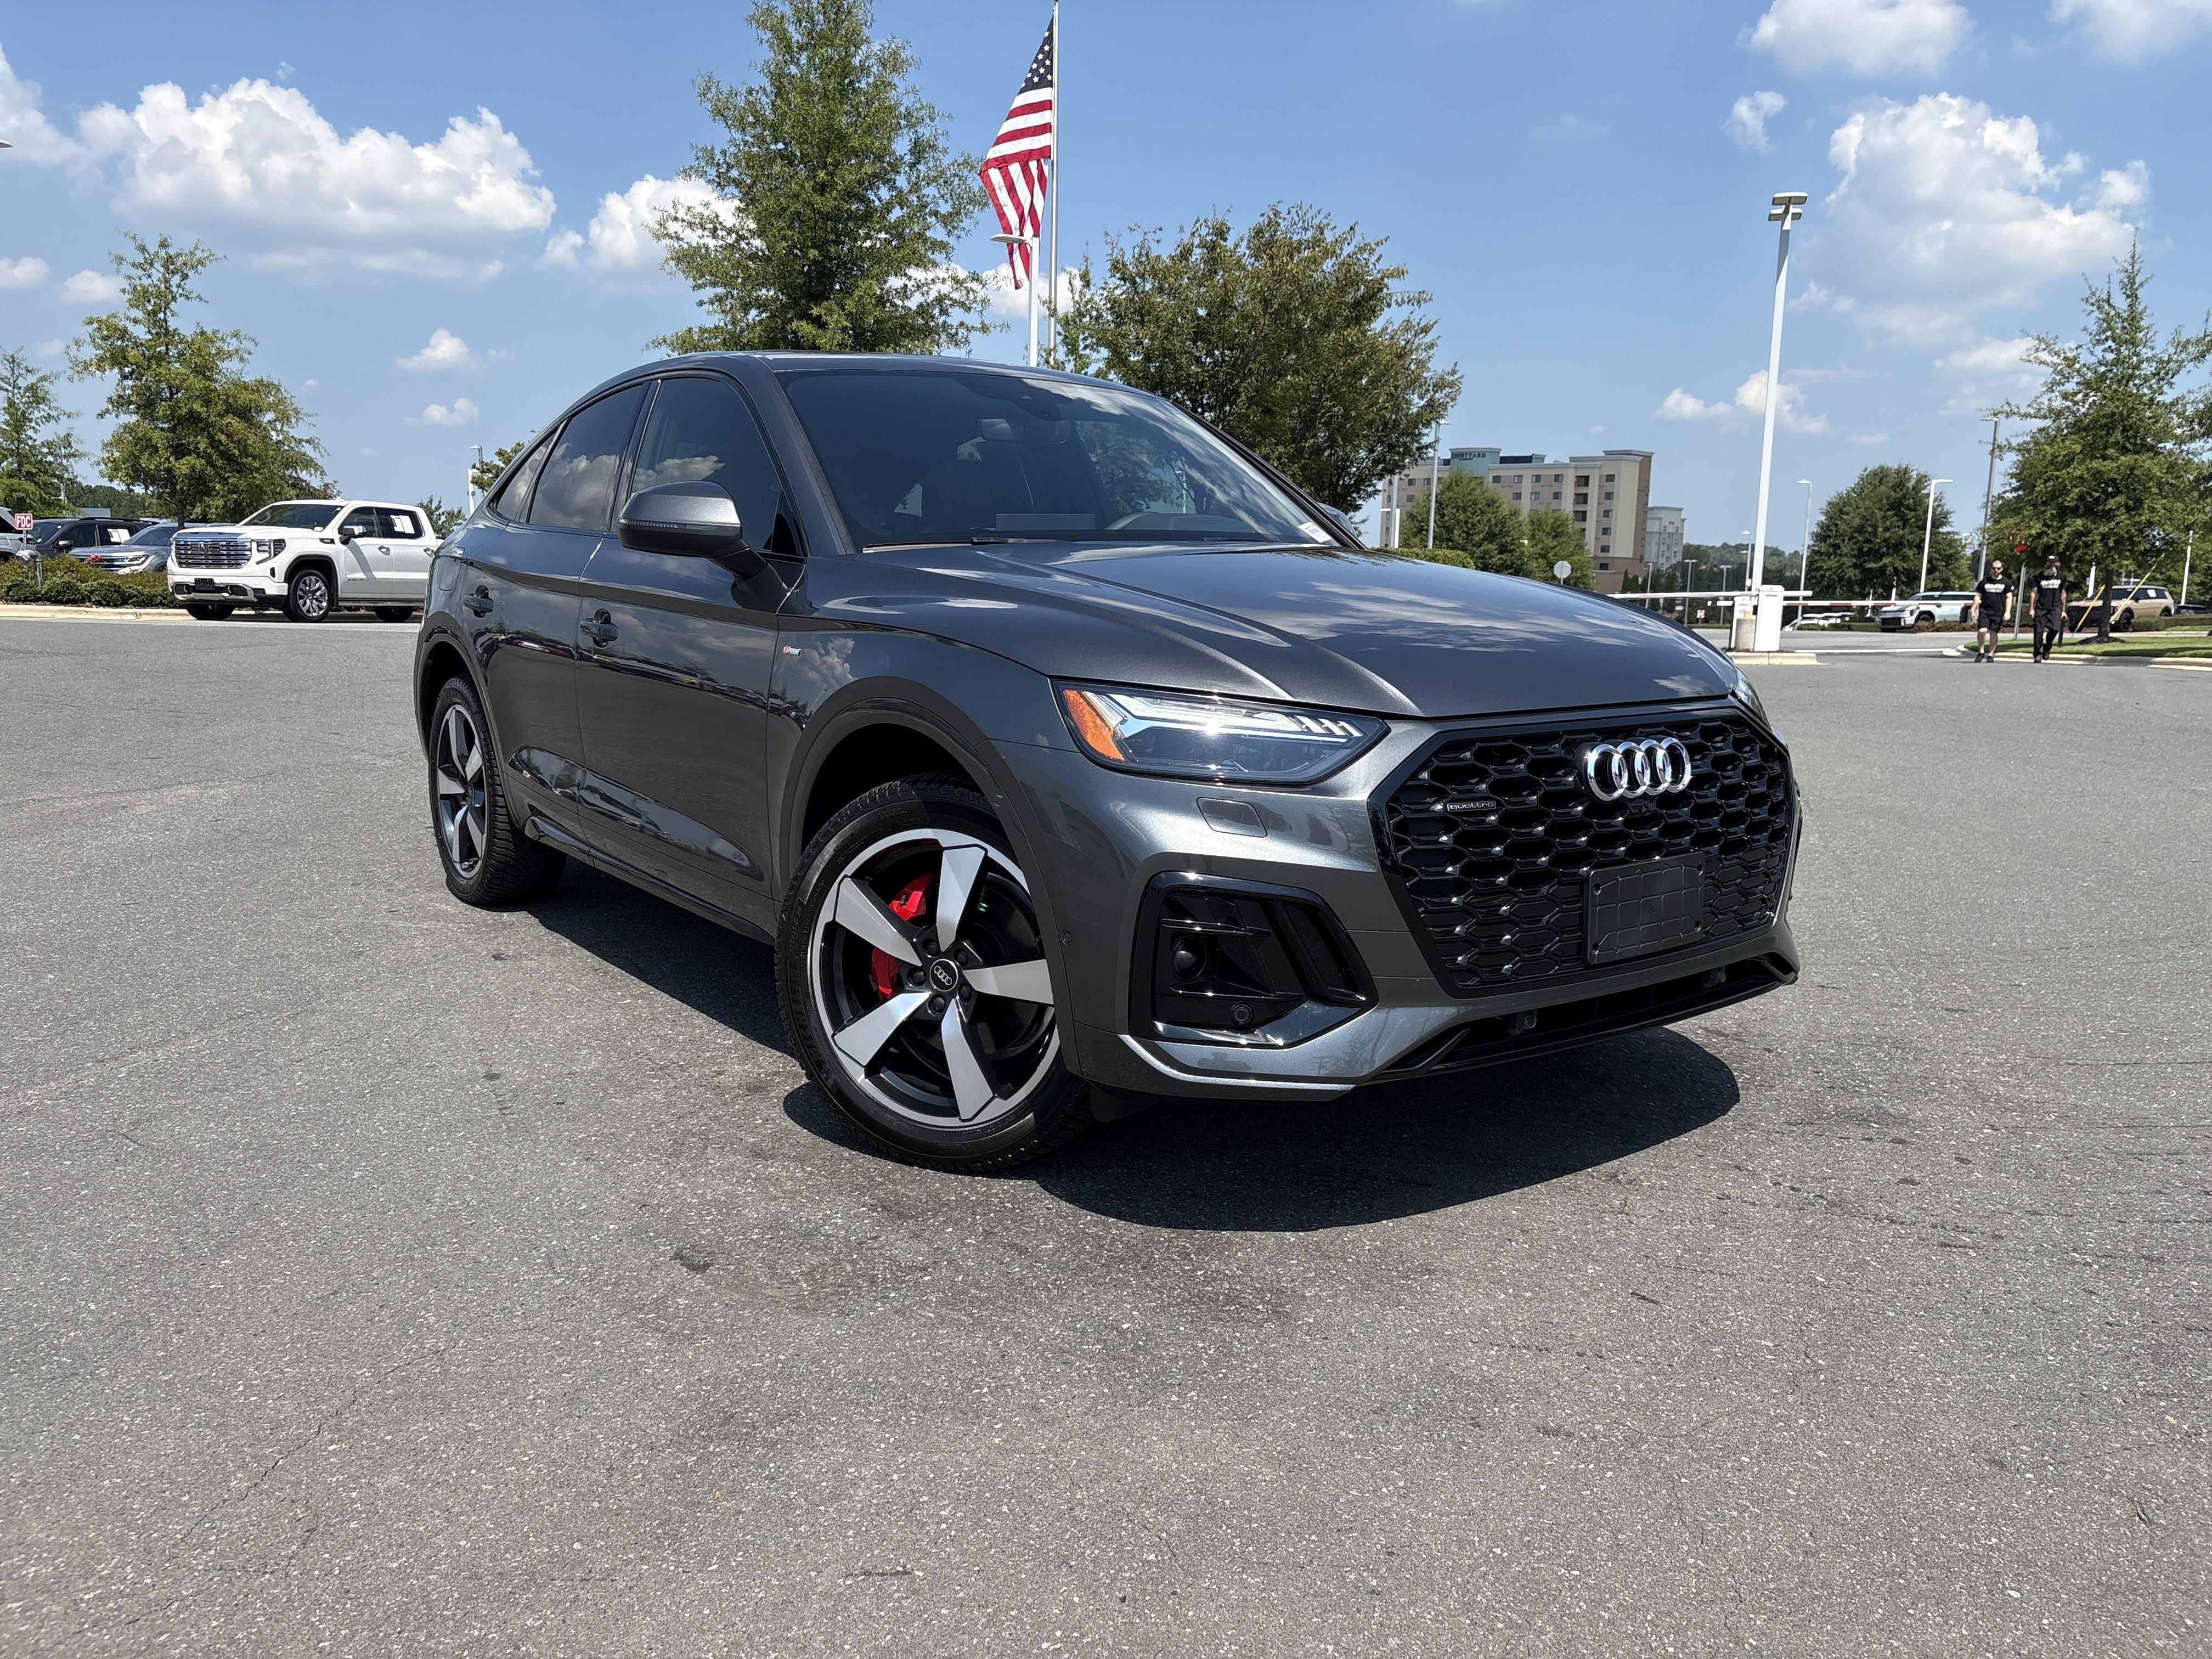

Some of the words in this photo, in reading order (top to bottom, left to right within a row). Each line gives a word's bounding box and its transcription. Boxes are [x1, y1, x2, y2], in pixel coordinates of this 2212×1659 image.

[17, 516, 31, 527] FDC
[1450, 802, 1494, 811] quattro
[789, 968, 822, 1062] MICHELIN
